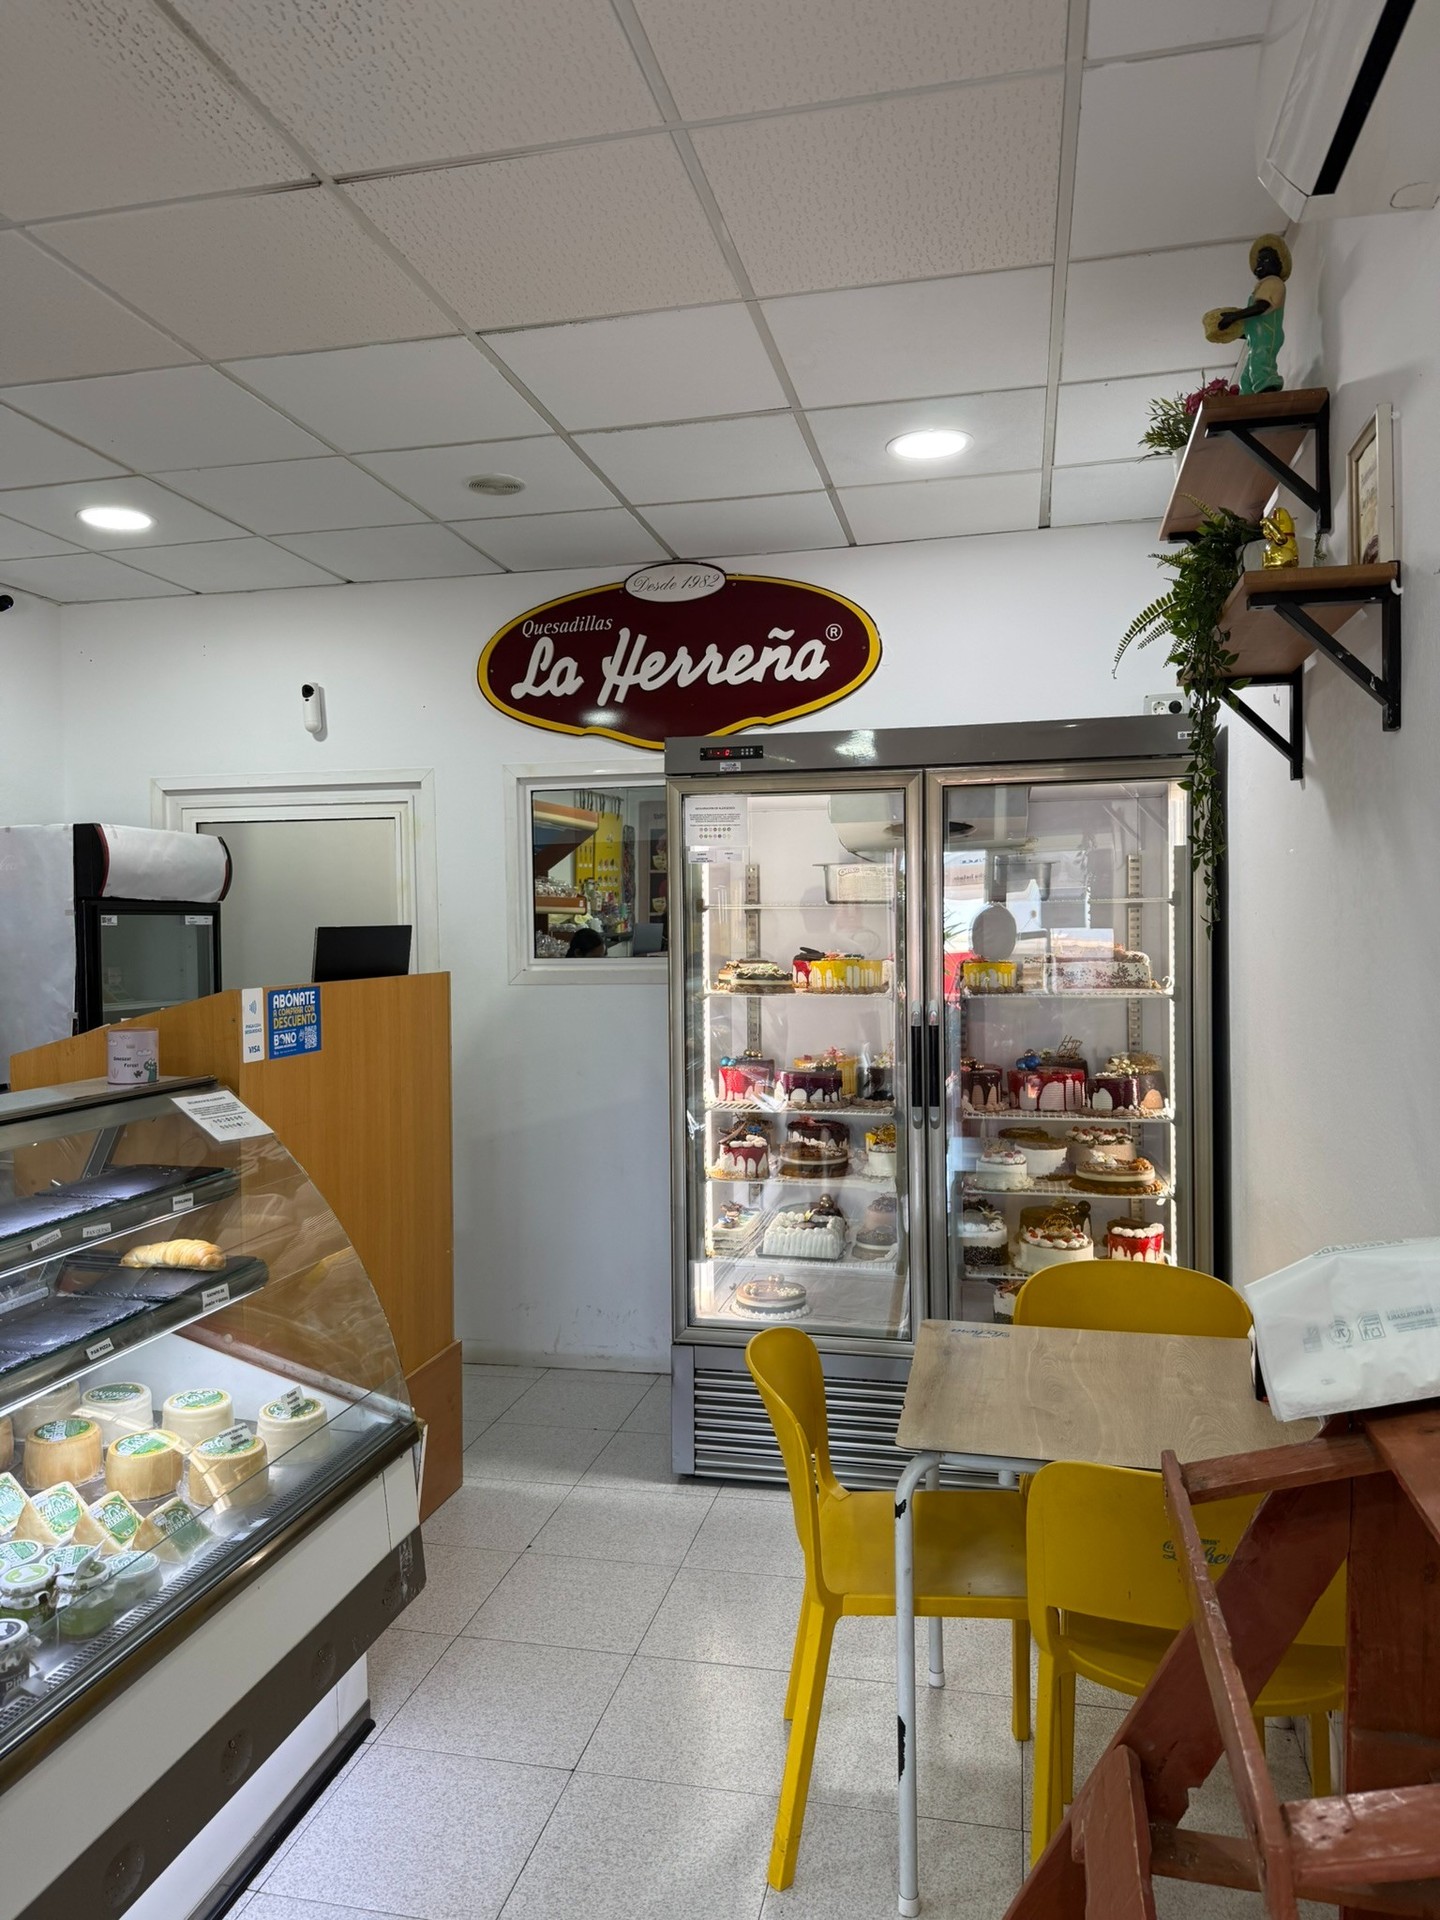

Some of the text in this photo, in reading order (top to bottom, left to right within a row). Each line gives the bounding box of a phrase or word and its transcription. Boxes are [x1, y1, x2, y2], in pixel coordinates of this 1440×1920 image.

[631, 572, 720, 593] Desde 1982
[521, 615, 613, 638] Quesadillas
[510, 636, 585, 700] La
[596, 626, 831, 707] Herreña
[273, 990, 316, 1009] ABÓNATE
[278, 1006, 304, 1016] COMPRAR
[304, 1004, 316, 1013] CON
[273, 1012, 318, 1030] DESCUENTO
[248, 1045, 261, 1054] VISA
